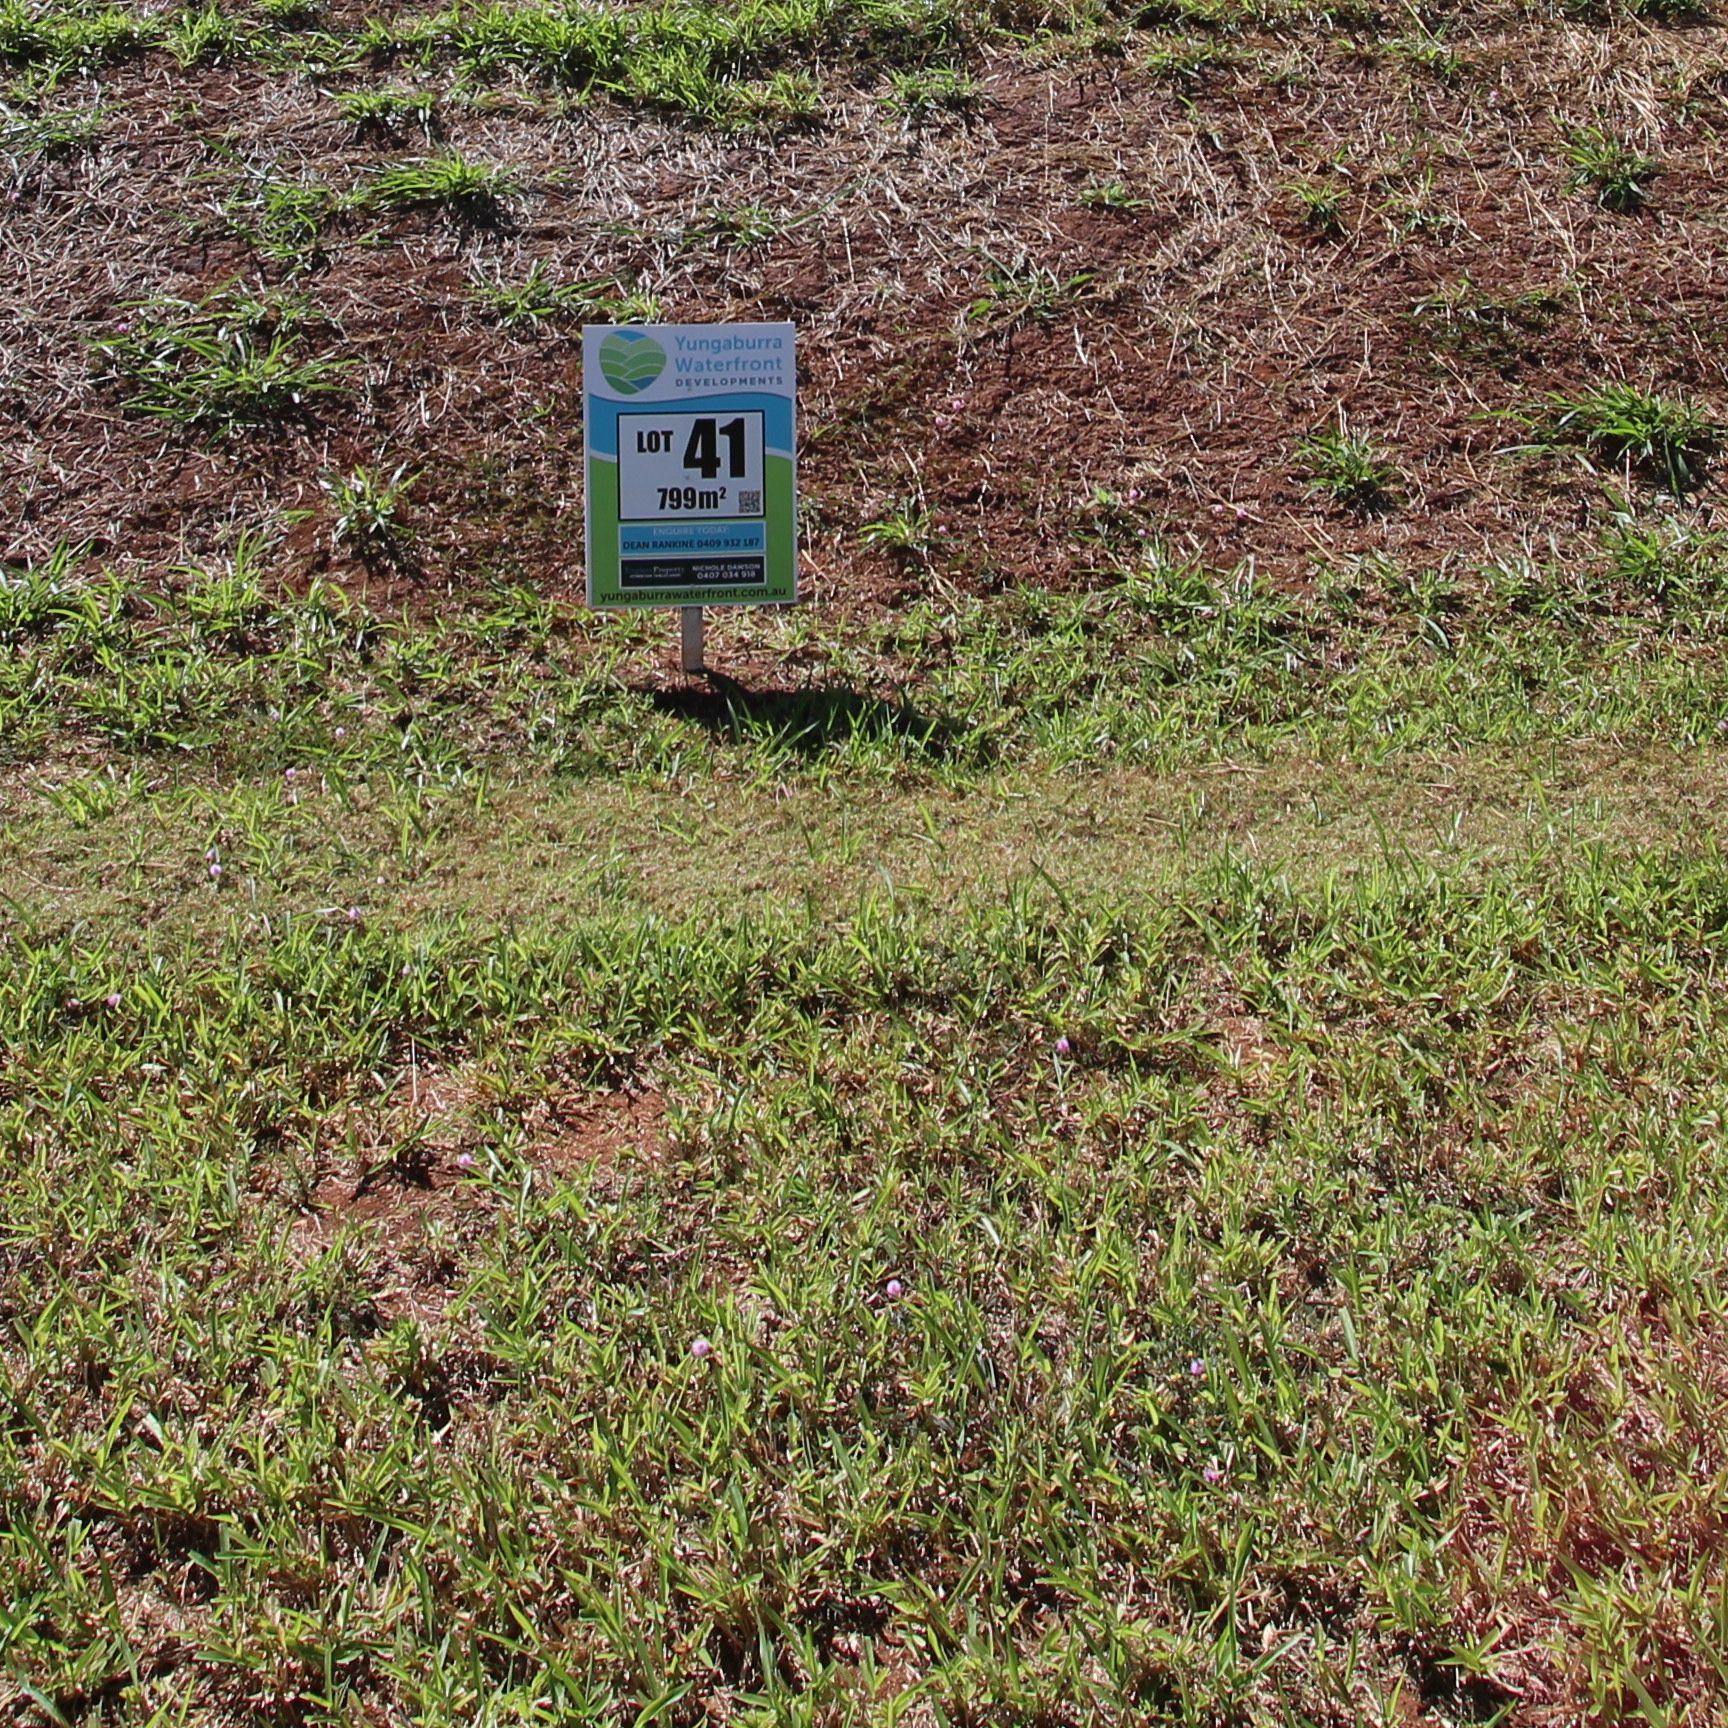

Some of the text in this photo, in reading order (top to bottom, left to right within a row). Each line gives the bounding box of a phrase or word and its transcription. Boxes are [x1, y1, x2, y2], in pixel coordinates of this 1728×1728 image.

[675, 335, 783, 353] Yungaburra
[675, 356, 783, 372] Waterfront
[675, 376, 783, 387] DEVELOPMENTS
[637, 417, 746, 479] LOT 41
[623, 541, 649, 549] DEAN
[652, 539, 695, 549] RANKINE
[697, 538, 722, 548] 0409
[600, 587, 787, 603] yungaburrawaterfront.com.au
